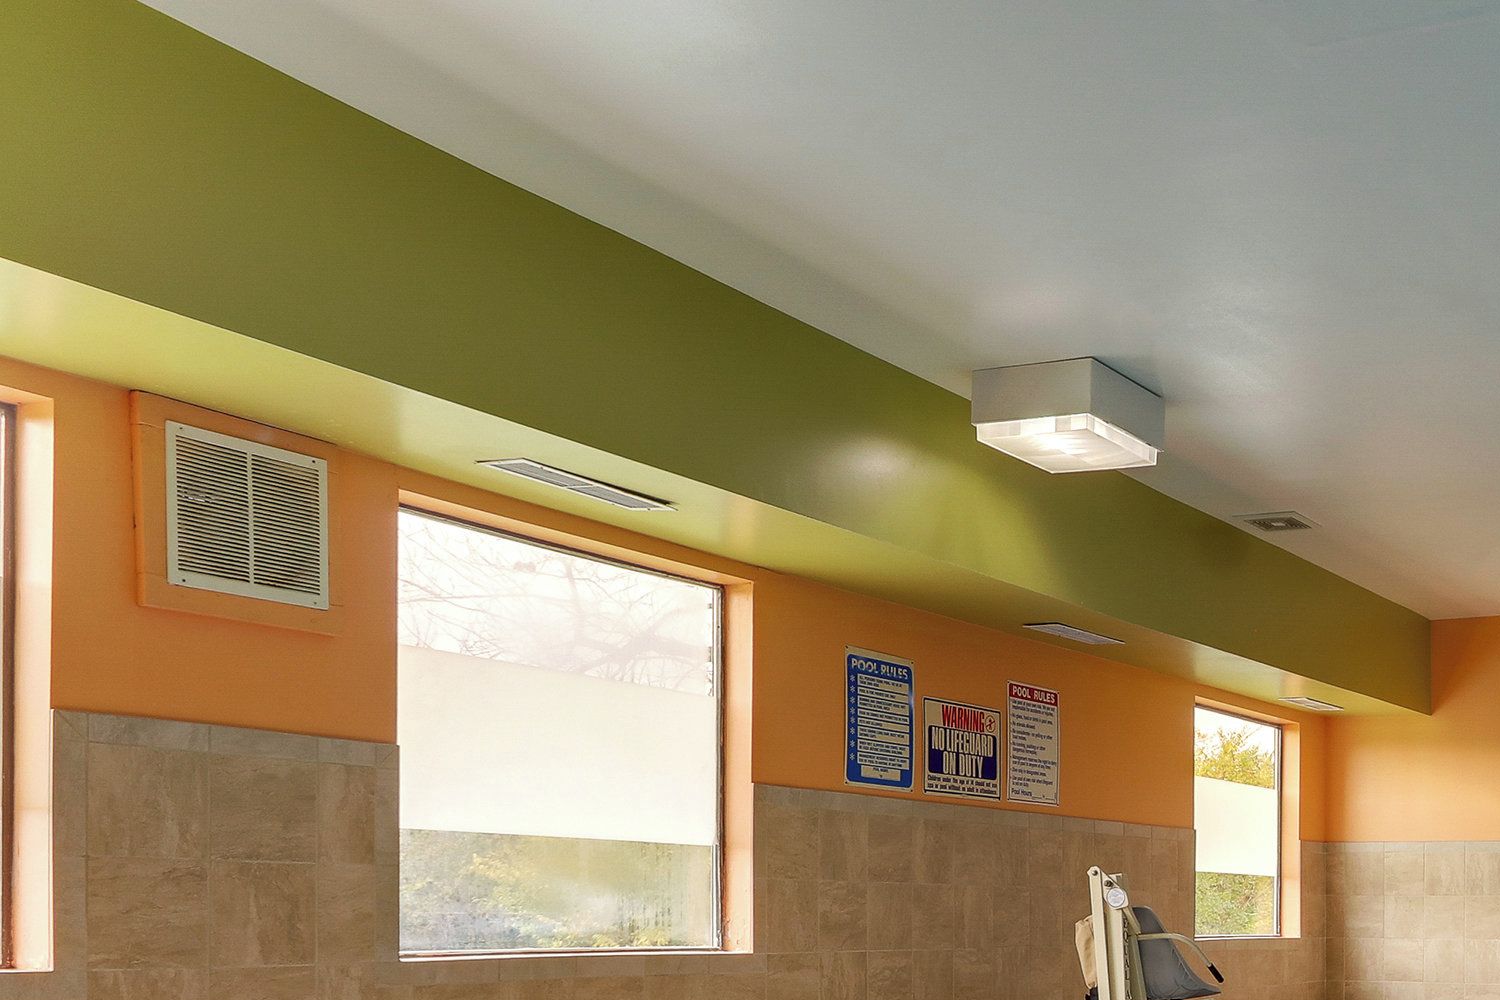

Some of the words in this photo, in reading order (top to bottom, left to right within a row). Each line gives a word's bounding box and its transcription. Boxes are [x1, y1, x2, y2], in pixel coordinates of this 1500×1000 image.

[851, 658, 878, 673] POOL
[881, 664, 908, 679] RULES
[1012, 685, 1031, 698] POOL
[1033, 690, 1055, 704] RULES
[942, 704, 985, 732] WARNING
[932, 726, 944, 750] NO
[946, 730, 993, 757] LIFEGUARD
[942, 751, 956, 774] ON
[959, 754, 983, 778] DUTY
[1011, 788, 1020, 796] Pool
[1021, 790, 1032, 798] Hours
